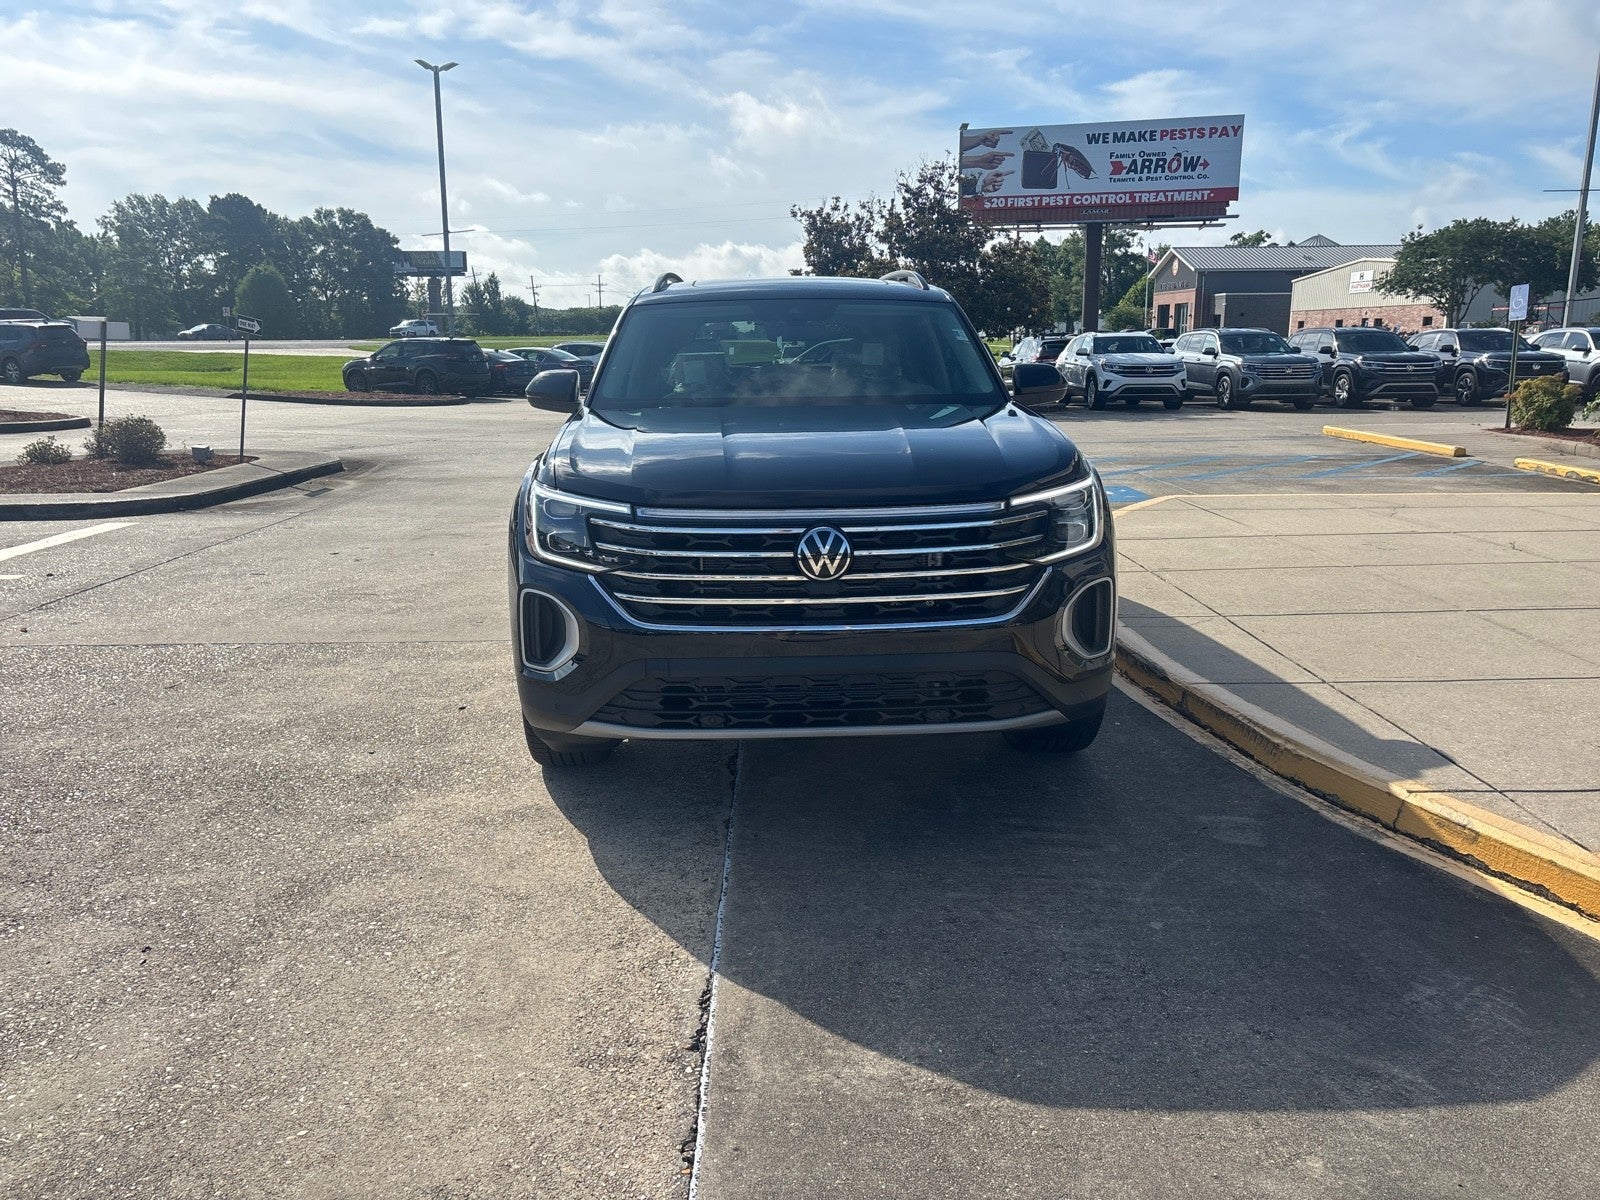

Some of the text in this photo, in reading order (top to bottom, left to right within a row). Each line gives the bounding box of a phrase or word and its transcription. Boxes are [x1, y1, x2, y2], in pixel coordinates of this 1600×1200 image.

[1086, 125, 1242, 145] WE MAKE PESTS PAY
[1109, 150, 1167, 160] FAMILY OWNED
[1125, 155, 1201, 175] ARROW
[983, 197, 1005, 209] $20
[1007, 196, 1040, 208] FIRST
[1041, 195, 1071, 206] PEST
[1073, 192, 1131, 205] CONTROL
[798, 527, 850, 578] VW
